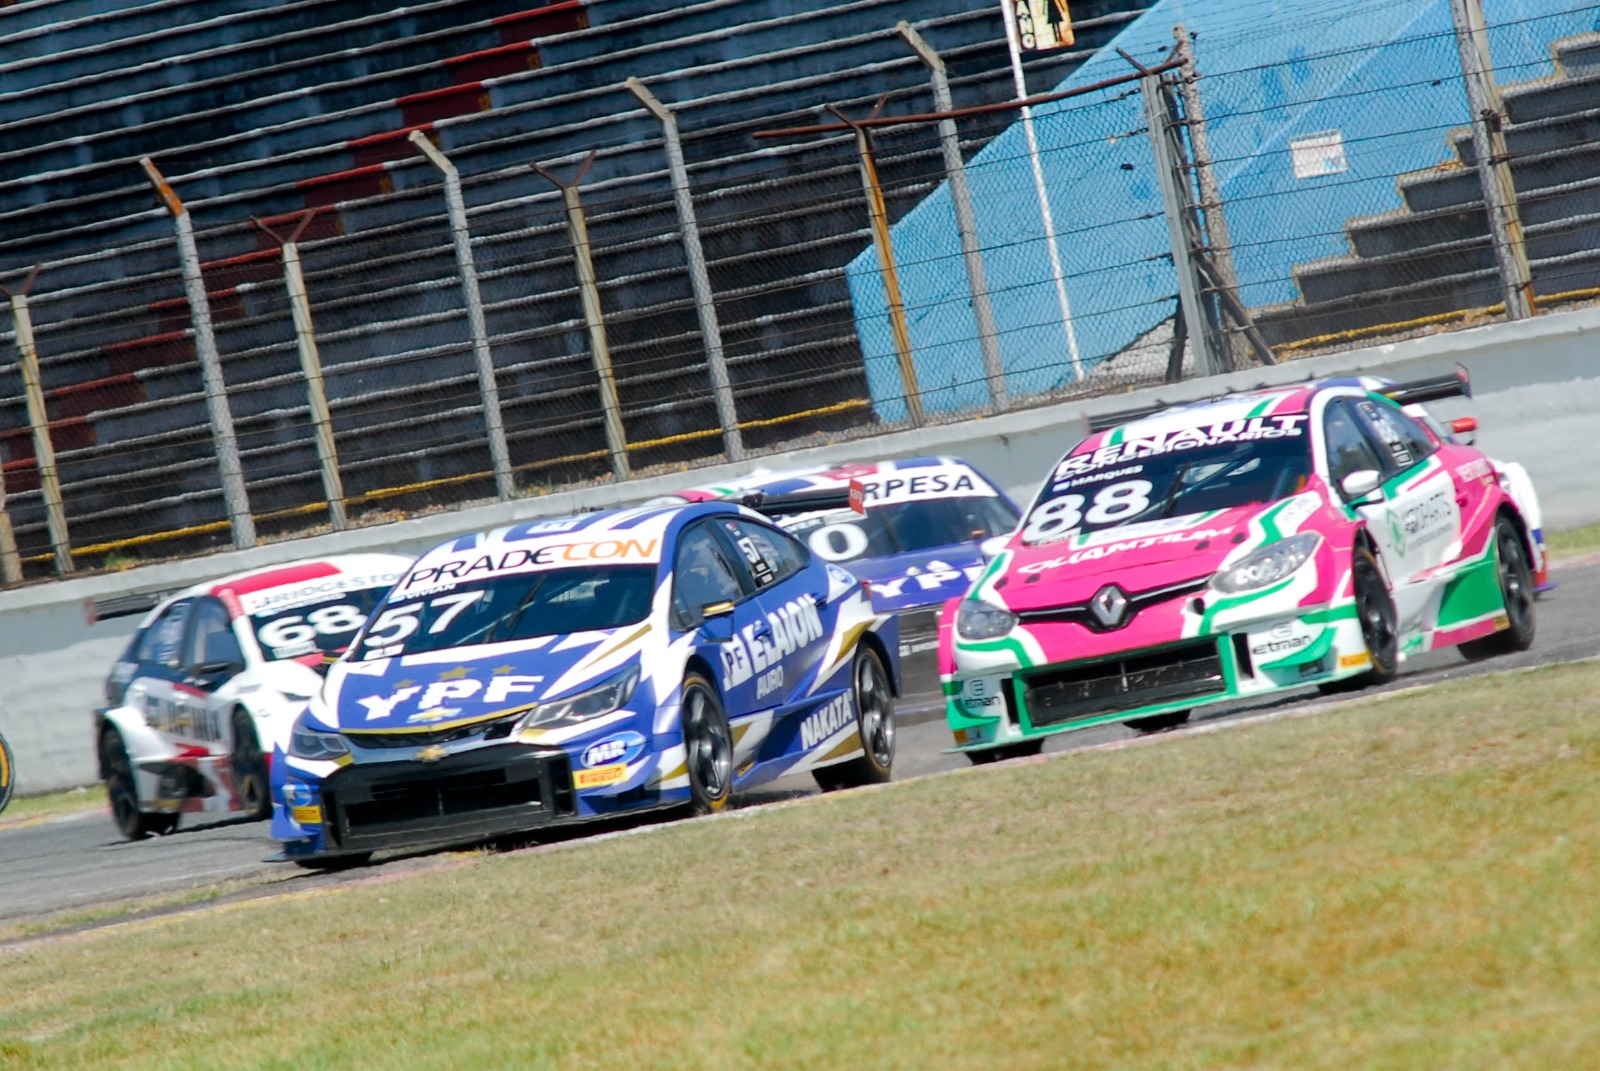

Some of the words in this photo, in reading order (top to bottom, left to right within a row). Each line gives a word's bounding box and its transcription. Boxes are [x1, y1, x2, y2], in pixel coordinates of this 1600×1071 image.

[1055, 414, 1309, 476] RENAULT
[862, 474, 975, 500] RPESA
[1071, 465, 1143, 487] MARQUES
[1021, 479, 1153, 542] 88
[404, 539, 657, 590] PRADECON
[800, 523, 869, 561] 0
[1017, 525, 1237, 574] QUANTUM
[257, 604, 368, 648] 68
[364, 590, 485, 648] 57
[742, 593, 823, 674] ELAION
[1252, 635, 1313, 655] etman
[355, 675, 544, 721] YPF
[801, 698, 853, 751] NAKATA
